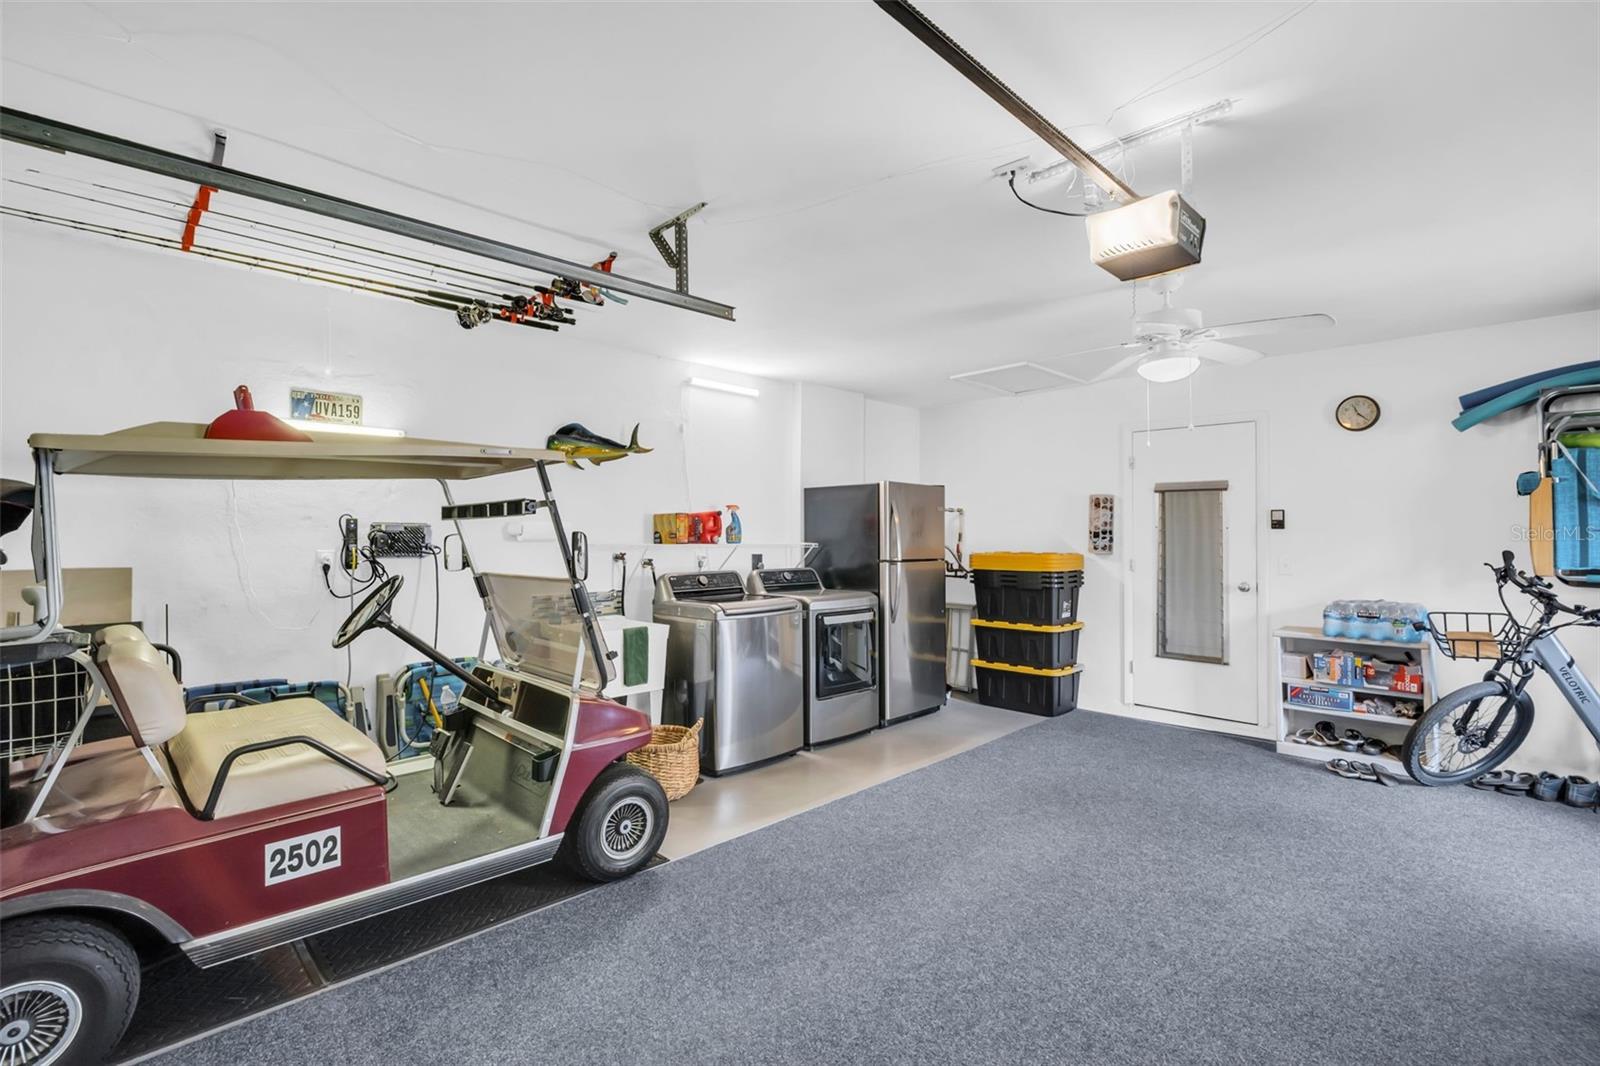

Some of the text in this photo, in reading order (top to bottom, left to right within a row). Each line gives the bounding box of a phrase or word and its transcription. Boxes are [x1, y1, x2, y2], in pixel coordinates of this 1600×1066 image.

[315, 401, 360, 419] UVA159
[1559, 666, 1591, 704] VELOTRIC
[269, 834, 338, 878] 2502
